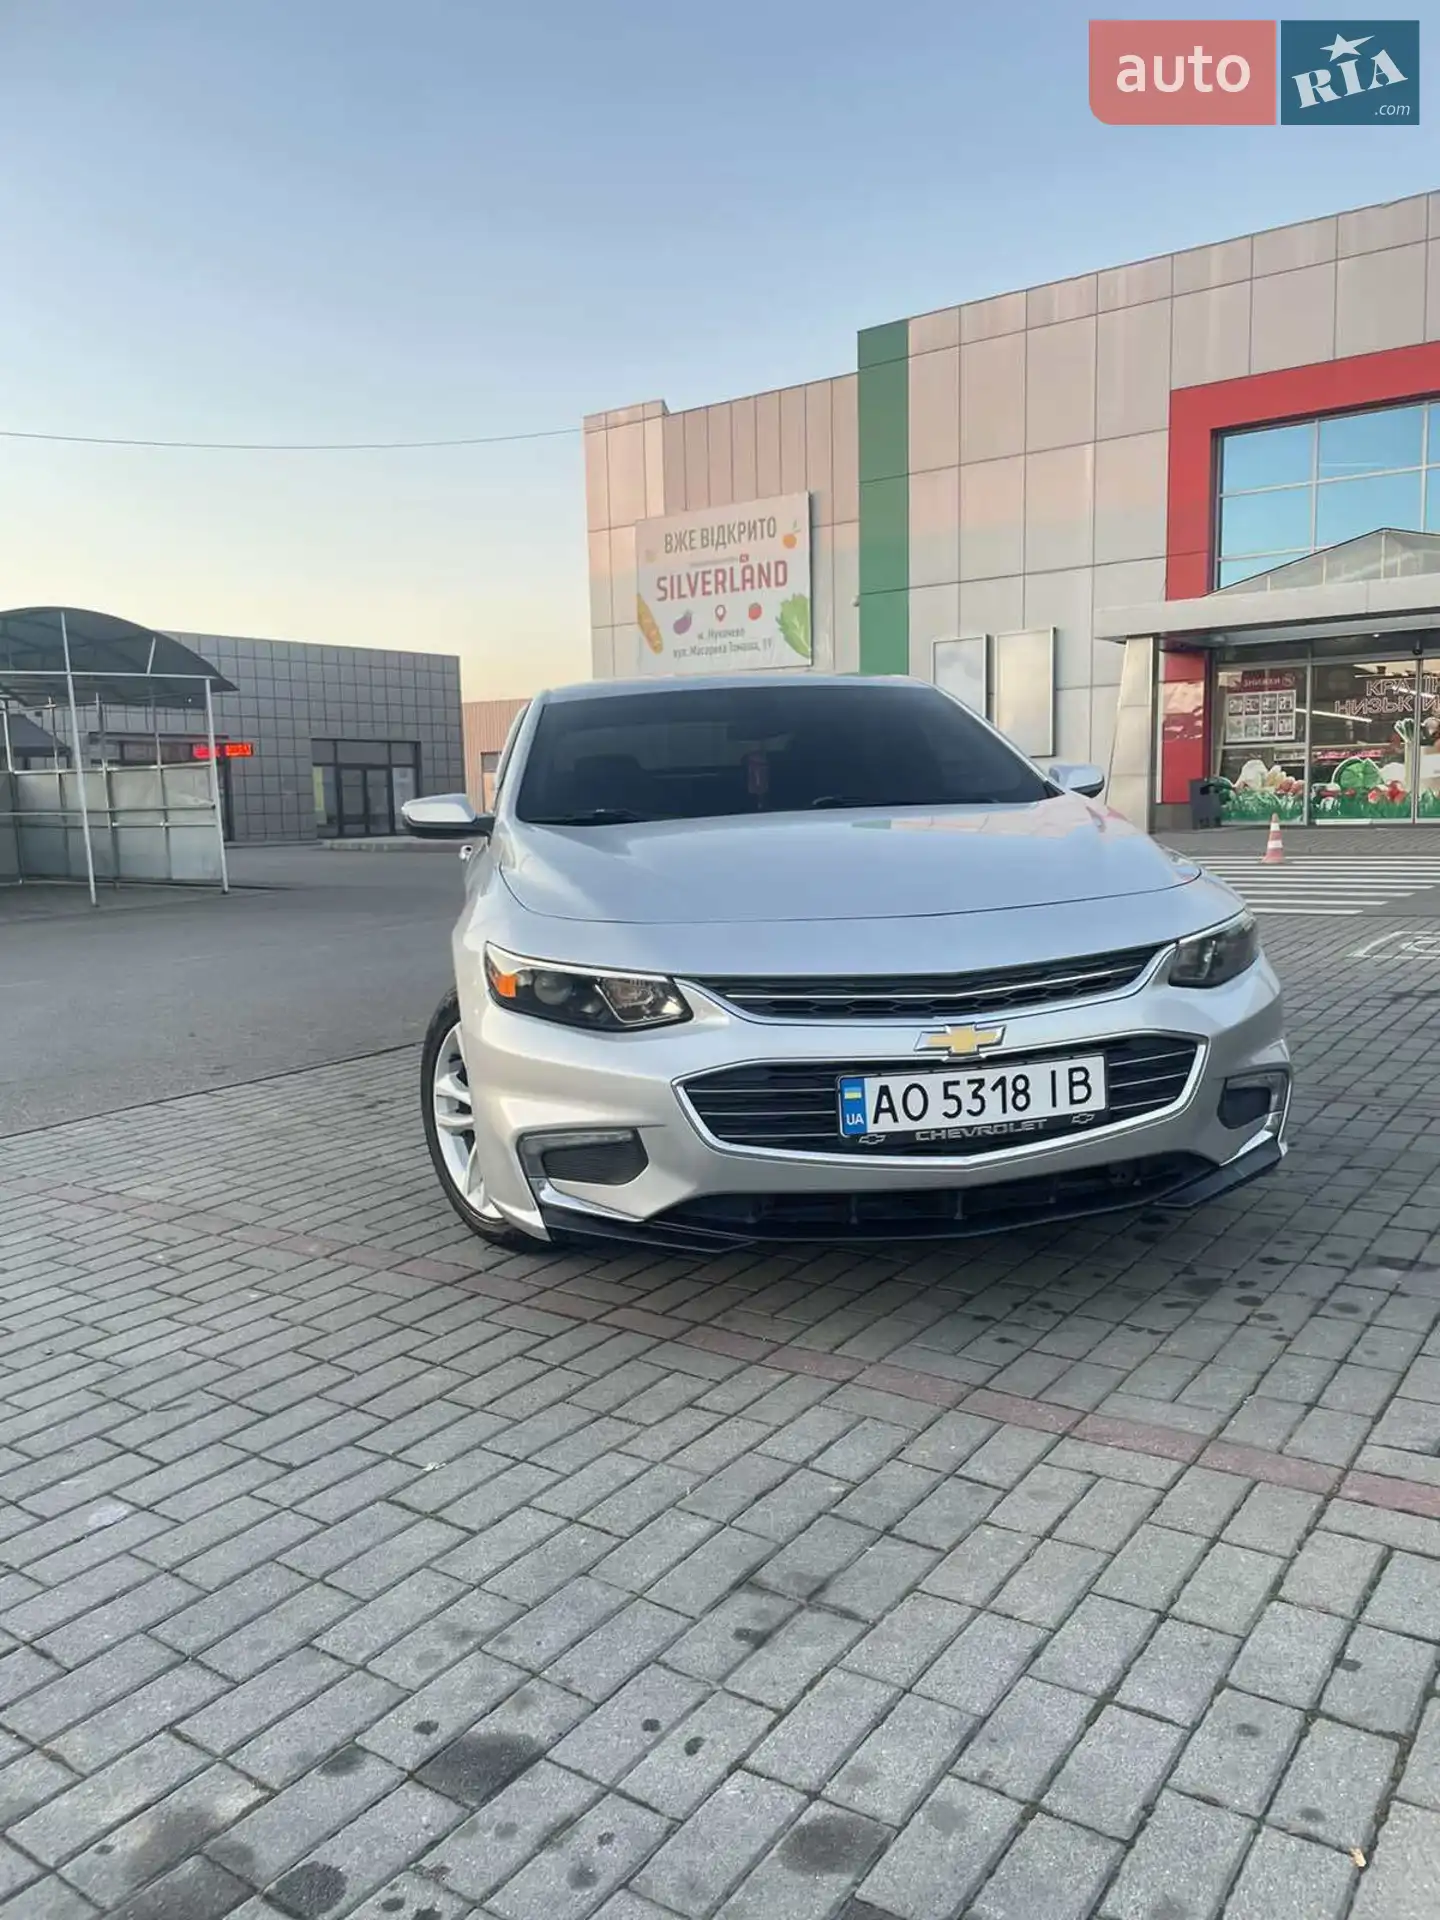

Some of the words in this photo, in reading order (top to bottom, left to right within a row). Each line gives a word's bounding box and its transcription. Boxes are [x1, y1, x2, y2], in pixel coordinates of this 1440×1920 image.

[664, 529, 697, 554] ВЖЕ
[700, 516, 778, 551] ВІДКРИТО
[656, 559, 788, 602] SILVERLAND
[872, 1082, 930, 1125] AO
[942, 1073, 1031, 1119] 5318
[1050, 1066, 1093, 1109] IB
[846, 1113, 865, 1125] UA
[915, 1119, 1048, 1142] CHEVROLET
